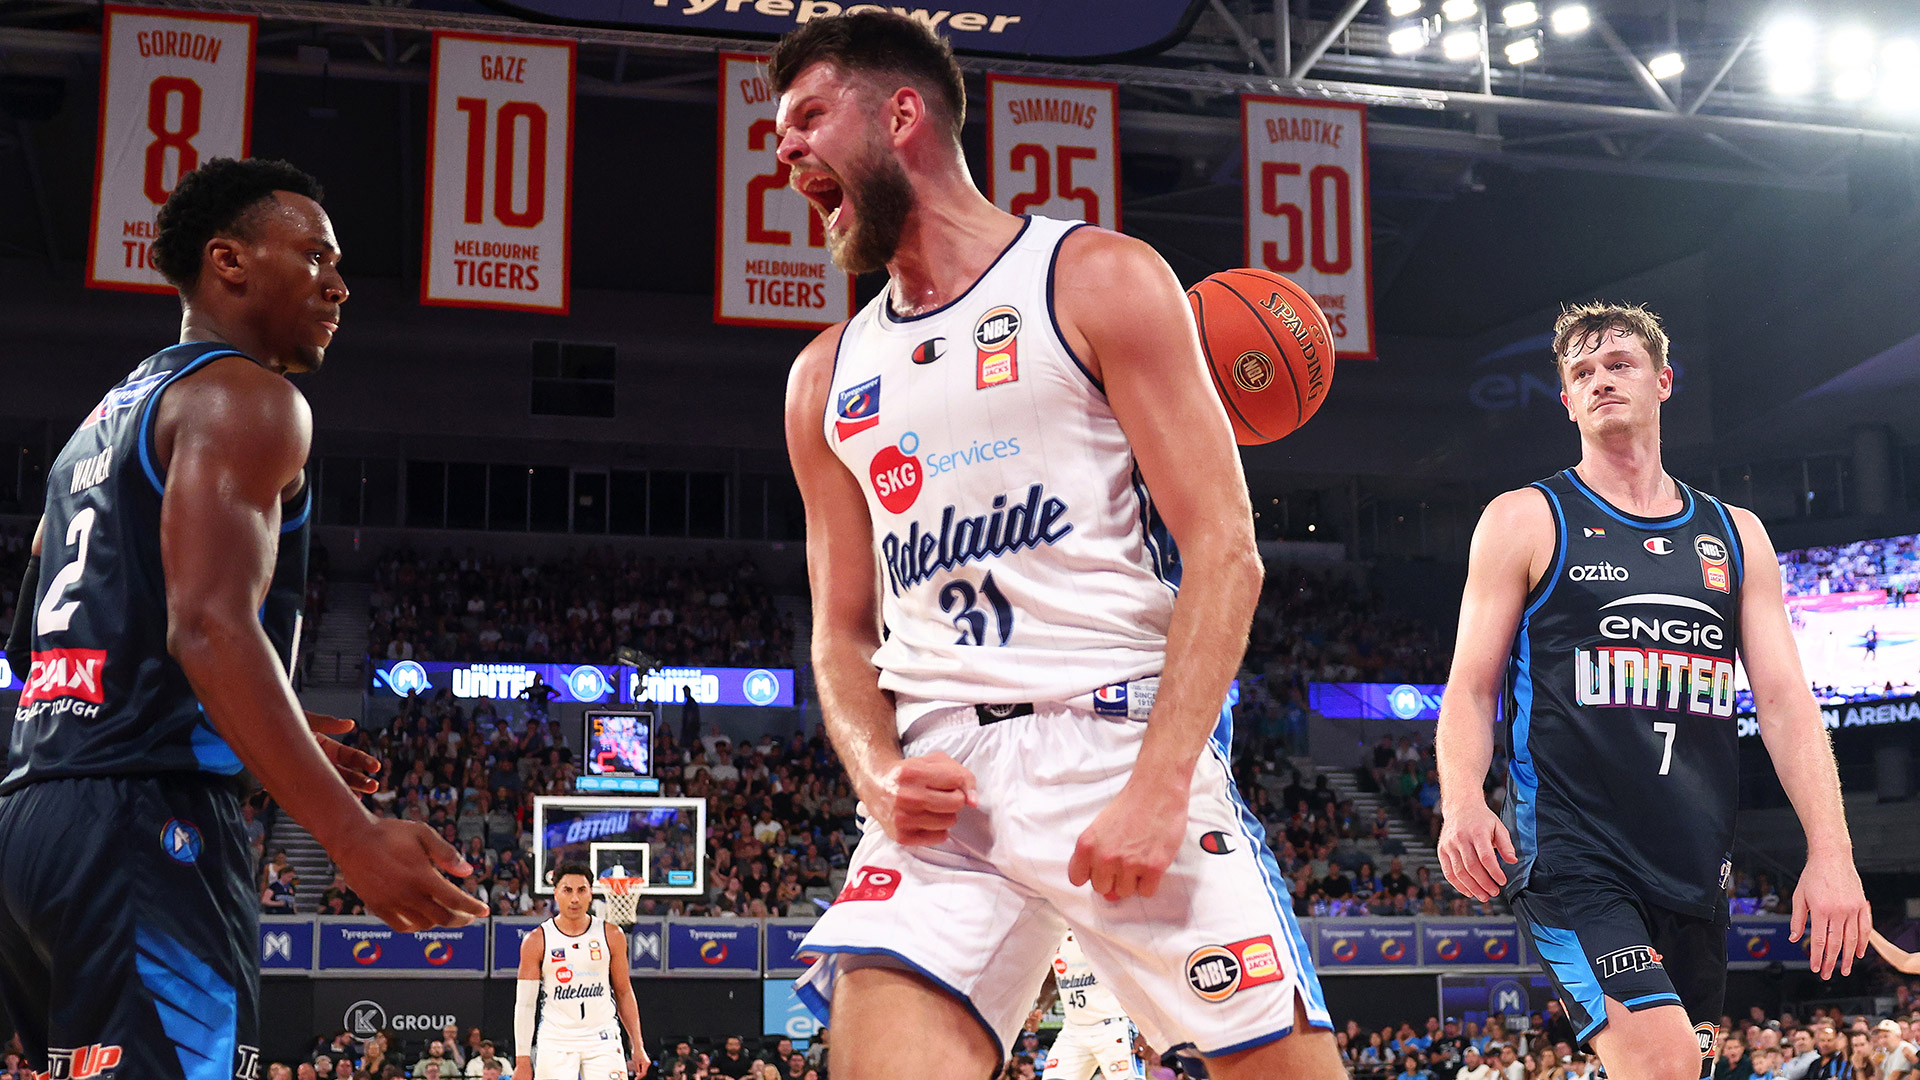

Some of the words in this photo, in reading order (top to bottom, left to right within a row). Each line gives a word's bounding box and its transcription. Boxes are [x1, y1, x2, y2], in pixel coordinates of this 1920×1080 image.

[137, 30, 222, 64] GORDON
[481, 55, 528, 84] GAZE
[1008, 98, 1097, 130] SIMMONS
[143, 75, 203, 206] 8
[1265, 117, 1344, 148] BRADTKE
[456, 96, 548, 229] 10
[1010, 142, 1099, 225] 25
[1261, 162, 1352, 275] 50
[454, 239, 540, 261] MELBOURNE
[453, 259, 540, 292] TIGERS
[745, 259, 827, 279] MELBOURNE
[745, 278, 827, 309] TIGERS
[982, 316, 1011, 342] NBL
[1258, 291, 1324, 402] SPALDING
[1242, 358, 1265, 385] NBL
[876, 463, 916, 497] SKG
[926, 437, 1021, 478] Services
[882, 483, 1074, 599] Adelaide
[1700, 542, 1723, 558] NBL
[37, 507, 96, 636] 2
[1569, 561, 1630, 582] ozito
[938, 569, 1015, 647] 31
[1576, 648, 1735, 718] UNITED
[1843, 701, 1920, 728] ARENA
[1653, 722, 1677, 775] 7
[341, 928, 392, 940] Tyrepower
[688, 928, 738, 940] Tyrepower
[1193, 958, 1232, 990] NBL
[554, 982, 604, 1001] Adelaide
[1068, 989, 1087, 1009] 45
[391, 1014, 457, 1031] GROUP
